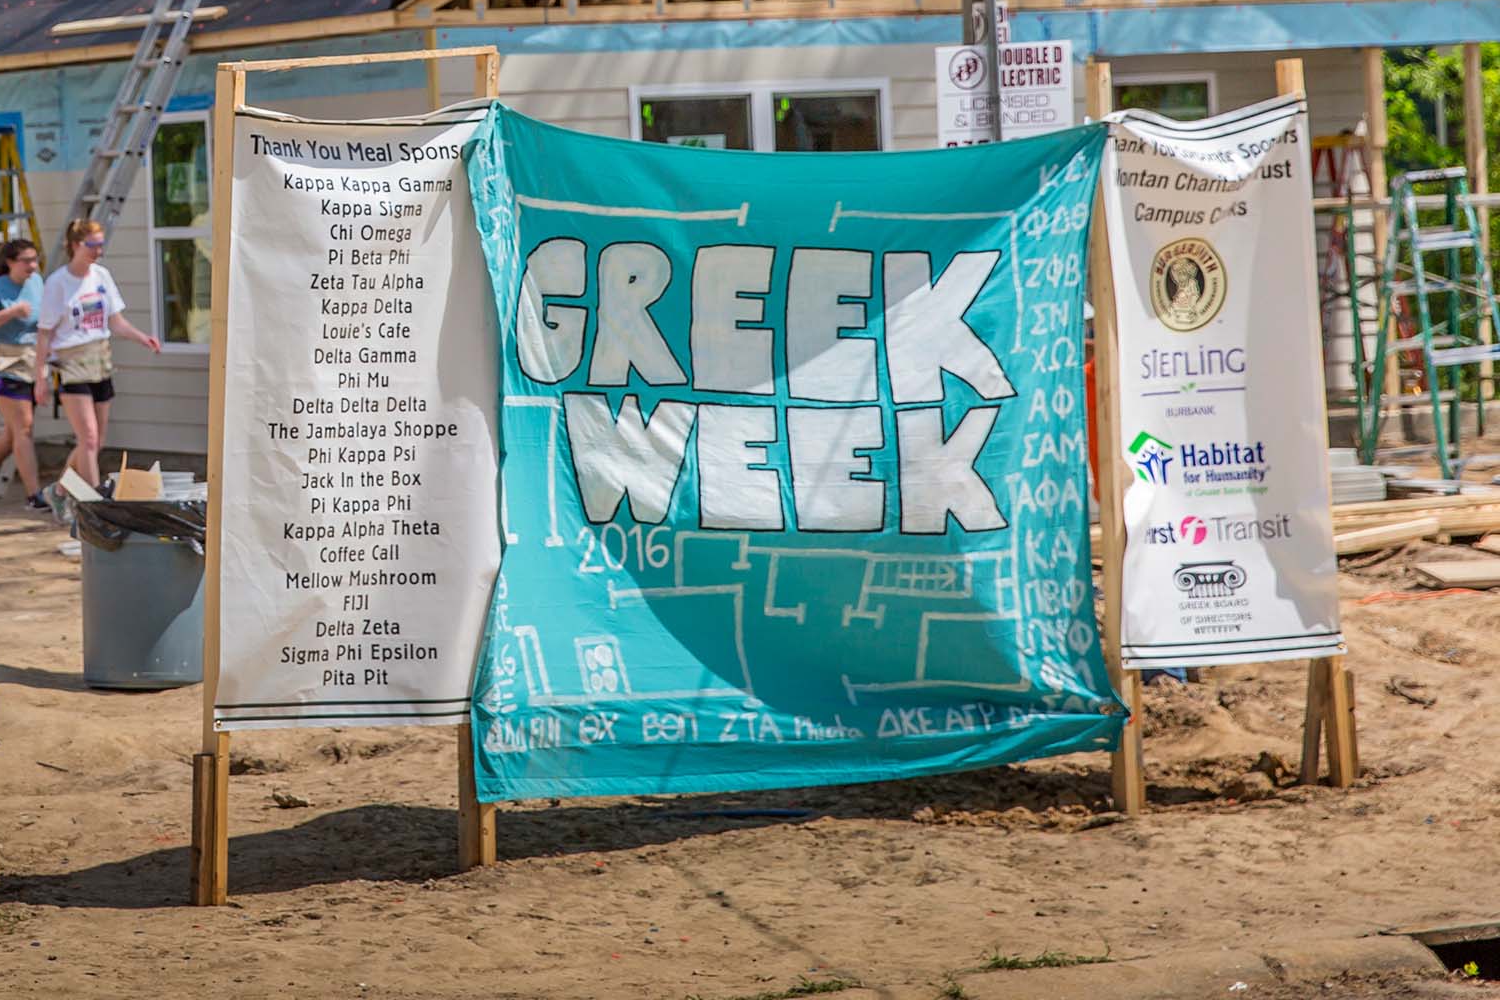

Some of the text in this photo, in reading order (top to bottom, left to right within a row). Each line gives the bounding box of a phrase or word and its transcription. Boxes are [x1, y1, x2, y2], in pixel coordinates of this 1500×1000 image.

[999, 46, 1062, 67] OUBLE D
[1002, 67, 1061, 87] LECTRIC
[250, 134, 302, 158] Thank
[306, 140, 341, 161] You
[347, 142, 393, 162] Meal
[283, 173, 452, 194] Kappa Kappa Gamma
[1117, 168, 1170, 189] ontan
[321, 199, 422, 219] Kappa Sigma
[1135, 202, 1205, 227] Campus
[330, 224, 412, 243] Chi Omega
[328, 249, 410, 265] Pi Beta Phi
[310, 274, 424, 293] Zeta Tau Alpha
[321, 298, 413, 317] Kappa Delta
[515, 235, 1018, 406] GREEK
[323, 322, 411, 340] Louie's Cafe
[314, 348, 417, 364] Delta Gamma
[338, 372, 389, 389] Phi Mu
[293, 396, 427, 415] Delta Delta Delta
[268, 420, 458, 442] The Jambalaya Shoppe
[308, 446, 416, 465] Phi Kappa Psi
[561, 391, 1009, 536] WEEK
[1181, 441, 1264, 467] Habitat
[302, 470, 422, 489] Jack In the Box
[1183, 467, 1265, 485] for Humanity
[311, 495, 411, 515] Pi Kappa Phi
[283, 520, 440, 542] Kappa Alpha Theta
[1210, 513, 1293, 541] Transit
[320, 544, 399, 564] Coffee Call
[576, 522, 671, 573] 2016
[286, 569, 437, 589] Mellow Mushroom
[343, 595, 369, 612] FIJI
[316, 619, 400, 637] Delta Zeta
[281, 643, 438, 665] Sigma Phi Epsilon
[323, 669, 389, 687] Pita Pit
